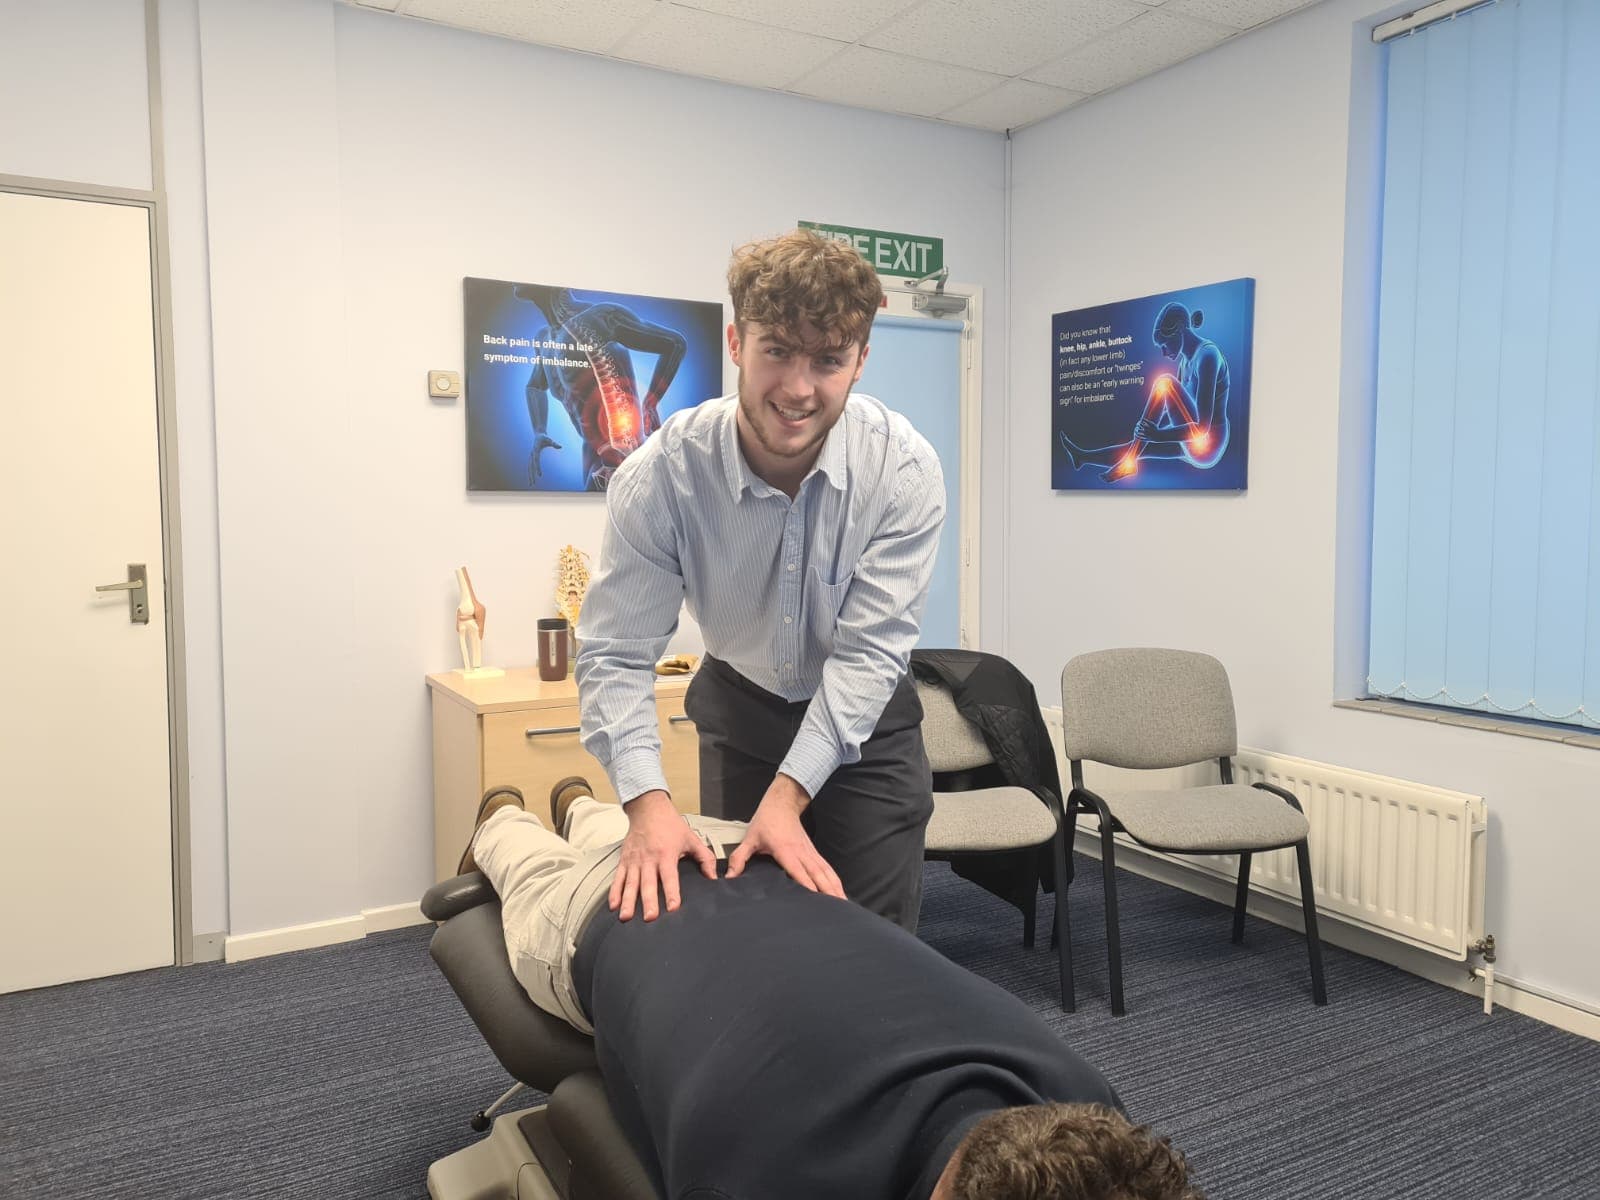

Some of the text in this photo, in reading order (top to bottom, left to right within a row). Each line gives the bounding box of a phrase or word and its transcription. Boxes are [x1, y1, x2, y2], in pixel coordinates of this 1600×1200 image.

[875, 237, 933, 273] EXIT
[1060, 325, 1111, 341] Did you know that
[483, 334, 594, 352] Back pain is often a late
[1060, 335, 1132, 353] knee, hip, ankle, buttock
[484, 354, 591, 368] symptom of imbalance.
[1068, 356, 1080, 364] fact
[1080, 356, 1091, 364] any
[1092, 353, 1109, 362] lower
[1110, 350, 1126, 360] limb)
[1060, 366, 1106, 380] pain/discomfort
[1072, 382, 1084, 390] also
[1120, 376, 1144, 386] warning
[1074, 396, 1083, 404] for
